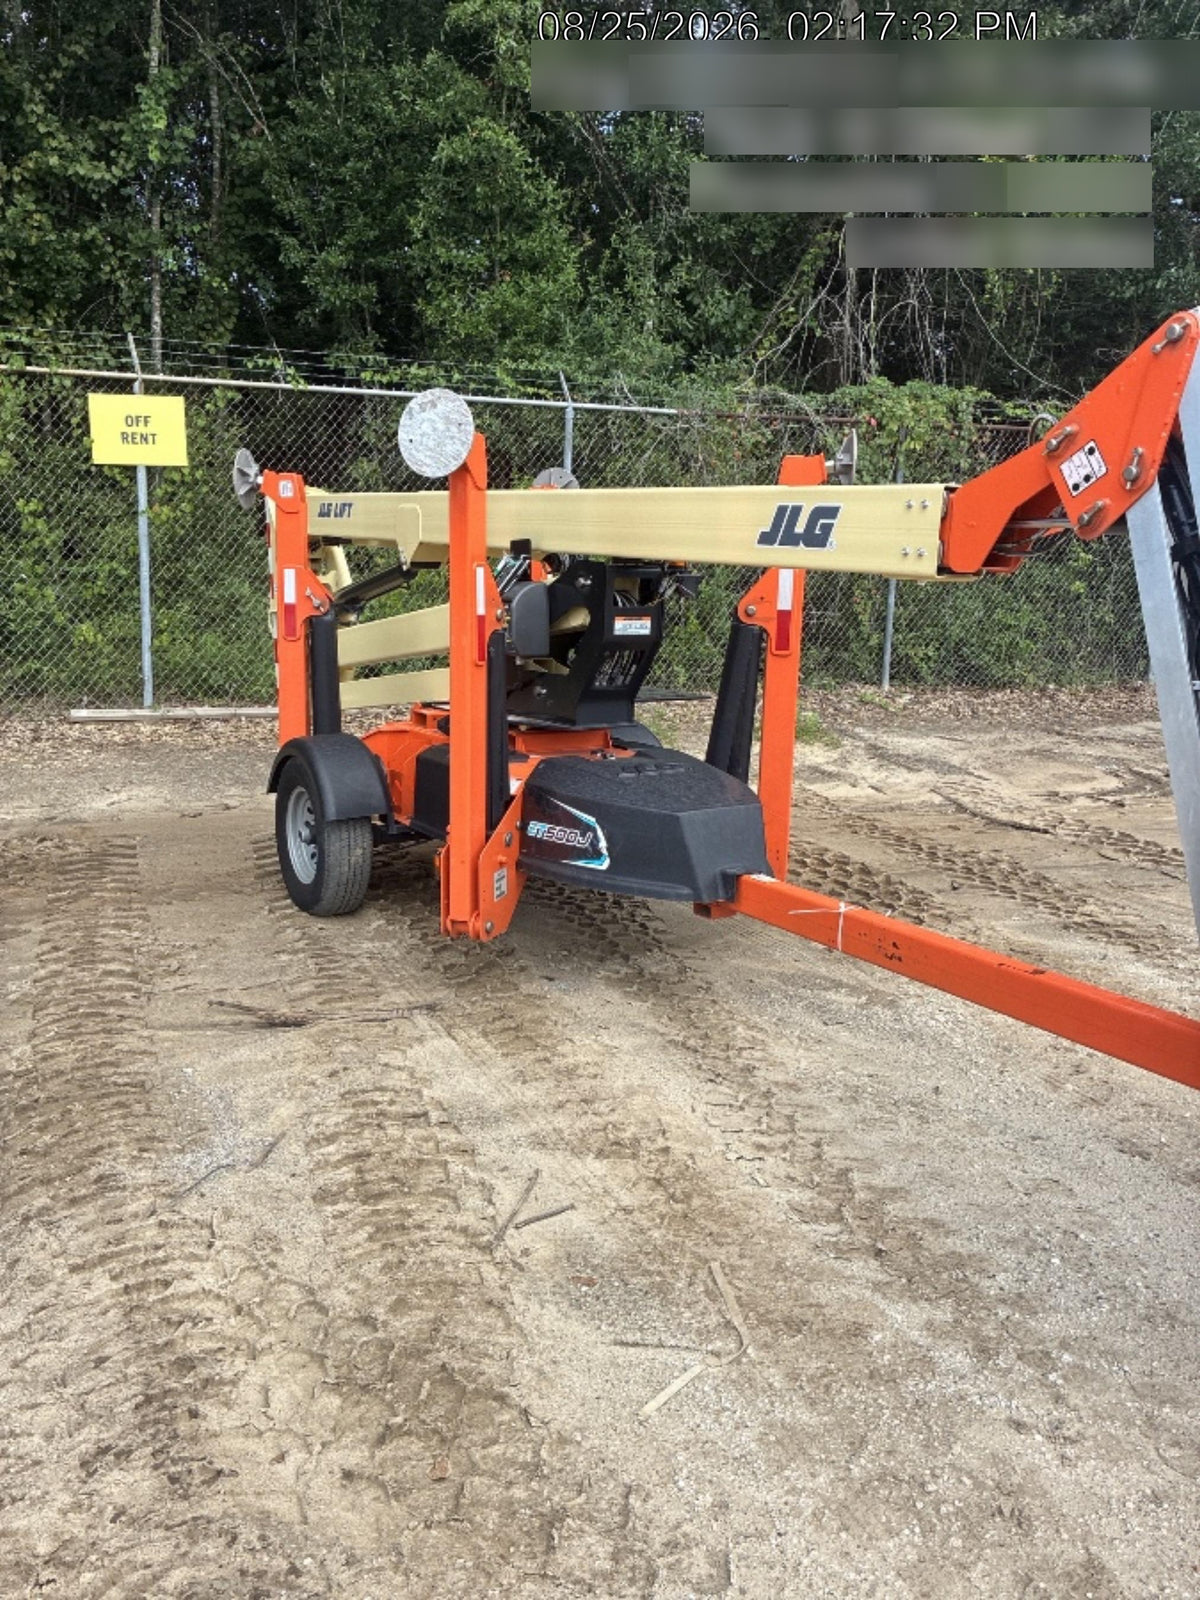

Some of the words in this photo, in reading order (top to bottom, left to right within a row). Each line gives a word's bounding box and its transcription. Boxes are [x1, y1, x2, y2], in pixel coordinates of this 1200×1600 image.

[125, 415, 151, 427] OFF
[121, 432, 157, 445] RENT
[334, 502, 353, 518] LIFT
[756, 503, 842, 548] JLG
